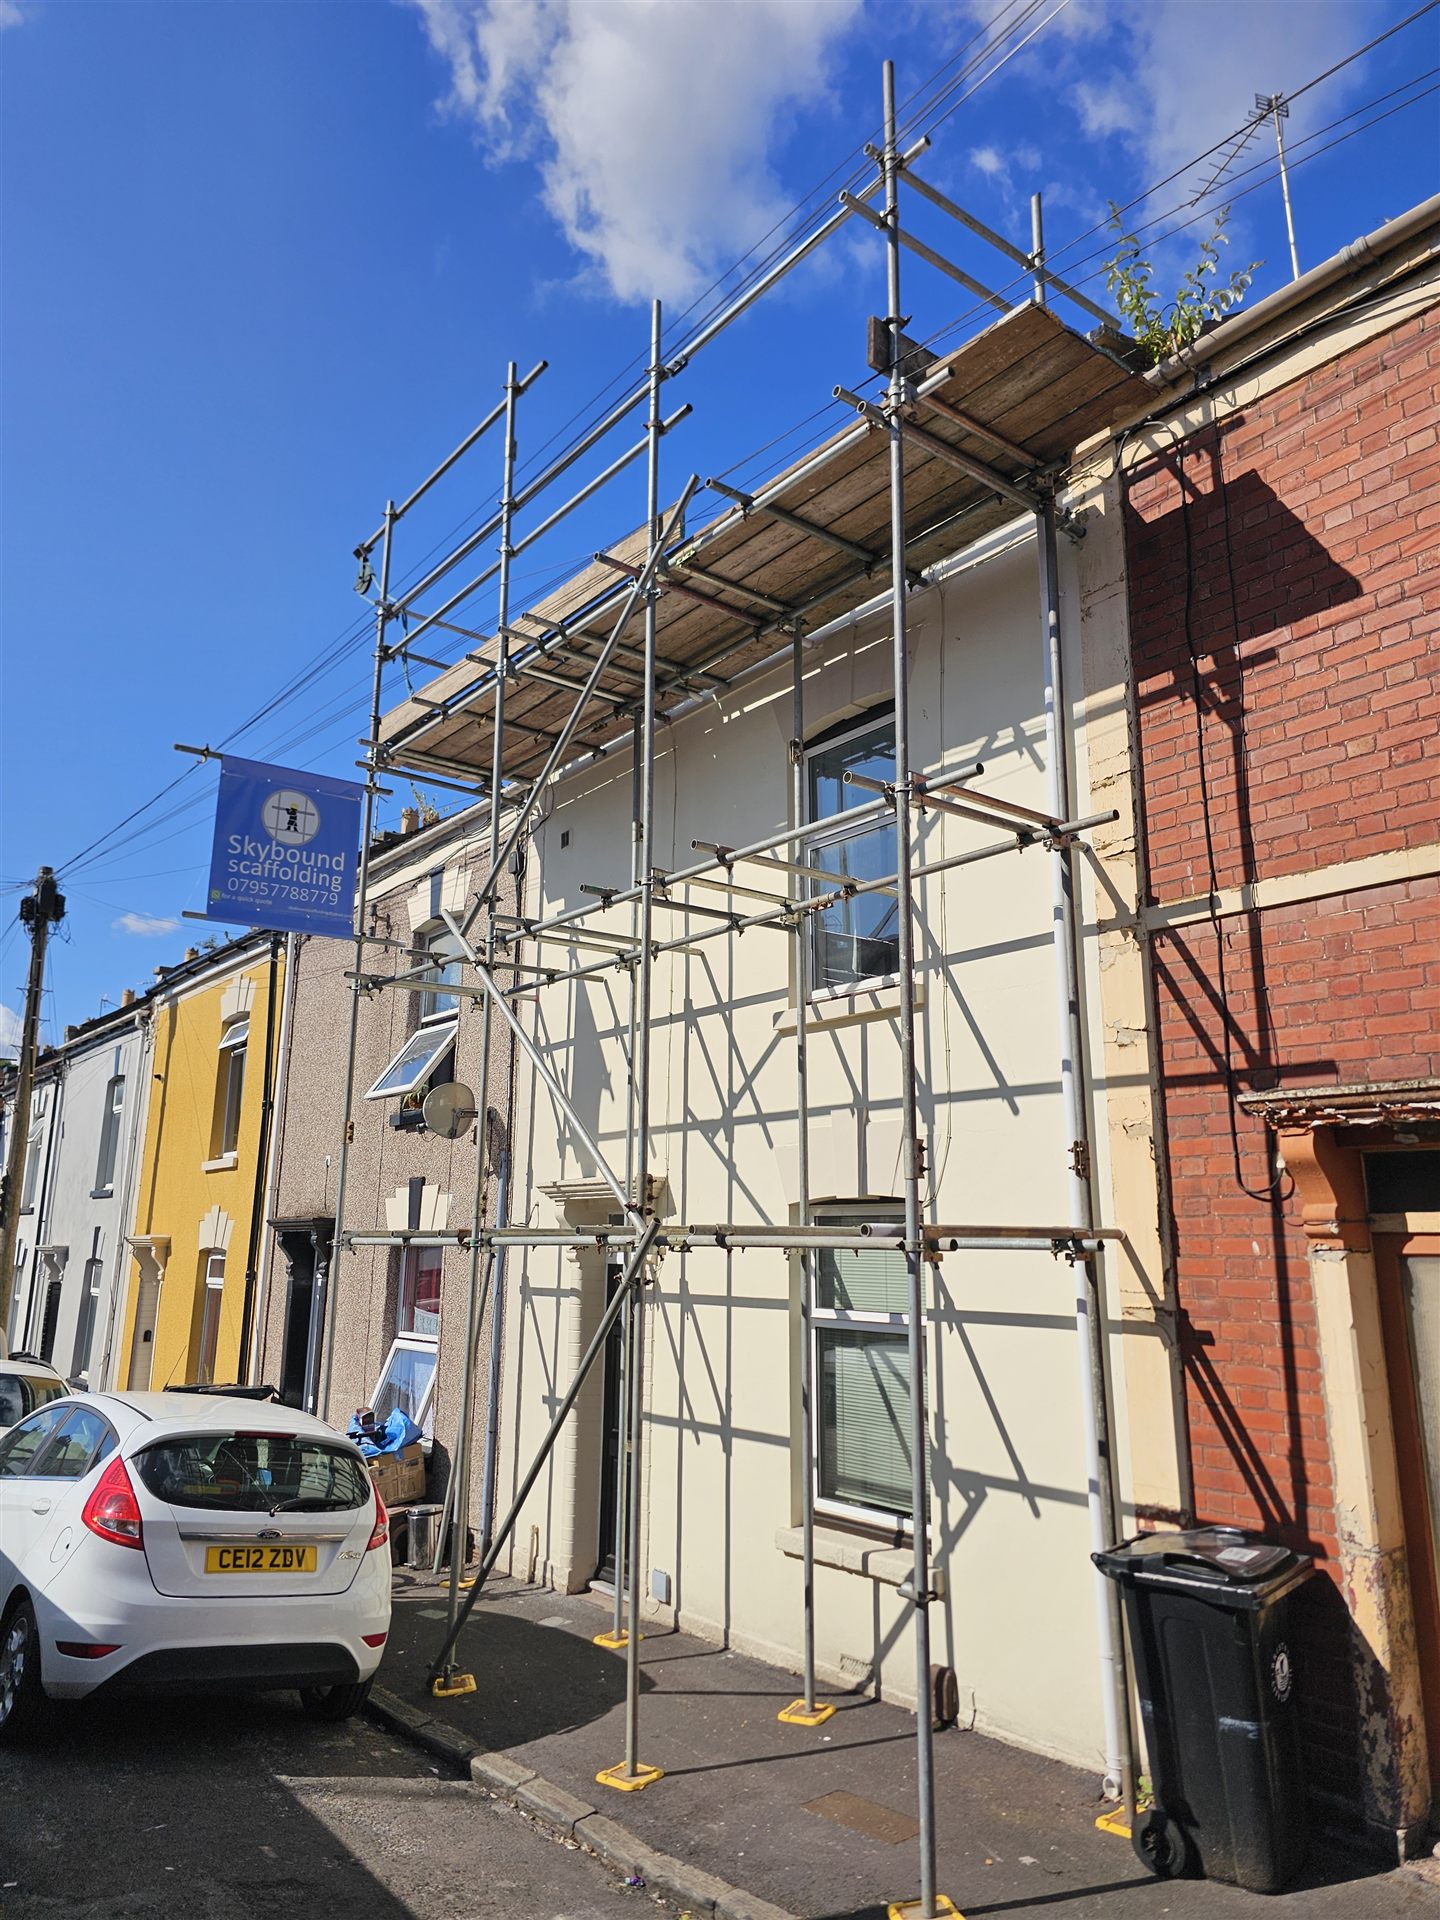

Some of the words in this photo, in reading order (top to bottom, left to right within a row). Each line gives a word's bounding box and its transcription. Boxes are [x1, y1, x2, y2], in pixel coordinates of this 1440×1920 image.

[227, 834, 345, 872] Skybound
[228, 859, 343, 893] scaffolding
[228, 877, 338, 906] 07957788779
[219, 1548, 263, 1569] CE12
[269, 1548, 306, 1568] ZDV
